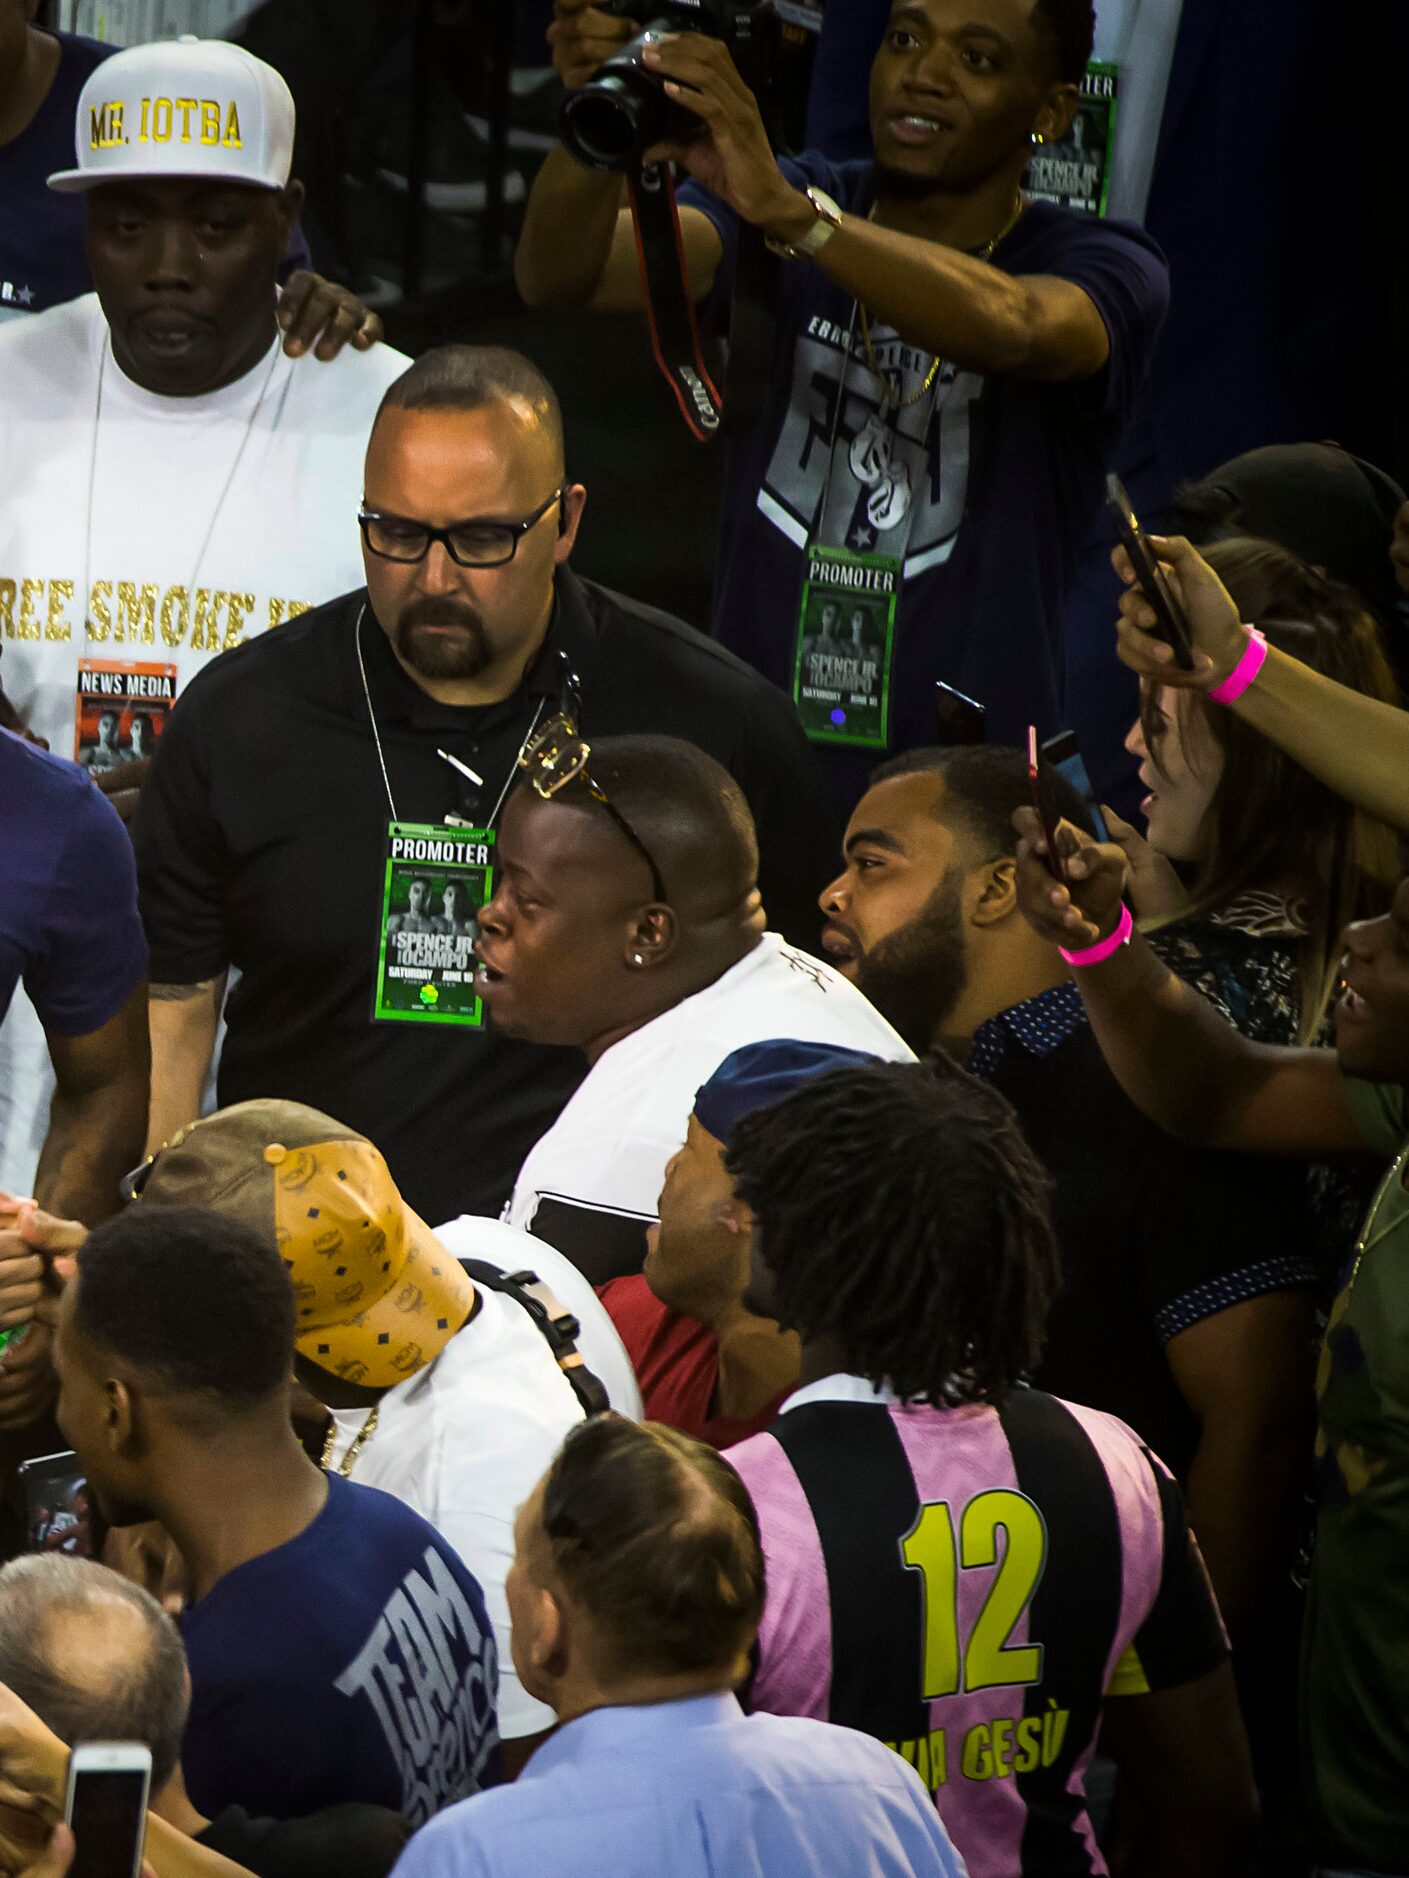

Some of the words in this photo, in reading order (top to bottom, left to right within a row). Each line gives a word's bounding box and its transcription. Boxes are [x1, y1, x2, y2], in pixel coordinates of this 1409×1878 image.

[90, 102, 130, 149] MR.
[139, 98, 243, 149] IOTBA
[809, 561, 894, 592] PROMOTER
[87, 580, 256, 652] SMOKE
[81, 671, 123, 695] NEWS
[126, 674, 172, 698] MEDIA
[392, 837, 489, 866] PROMOTER
[396, 931, 455, 953] SPENCE
[897, 1488, 1049, 1703] 12
[332, 1545, 484, 1766] TEAM
[960, 1697, 1071, 1782] GESÙ
